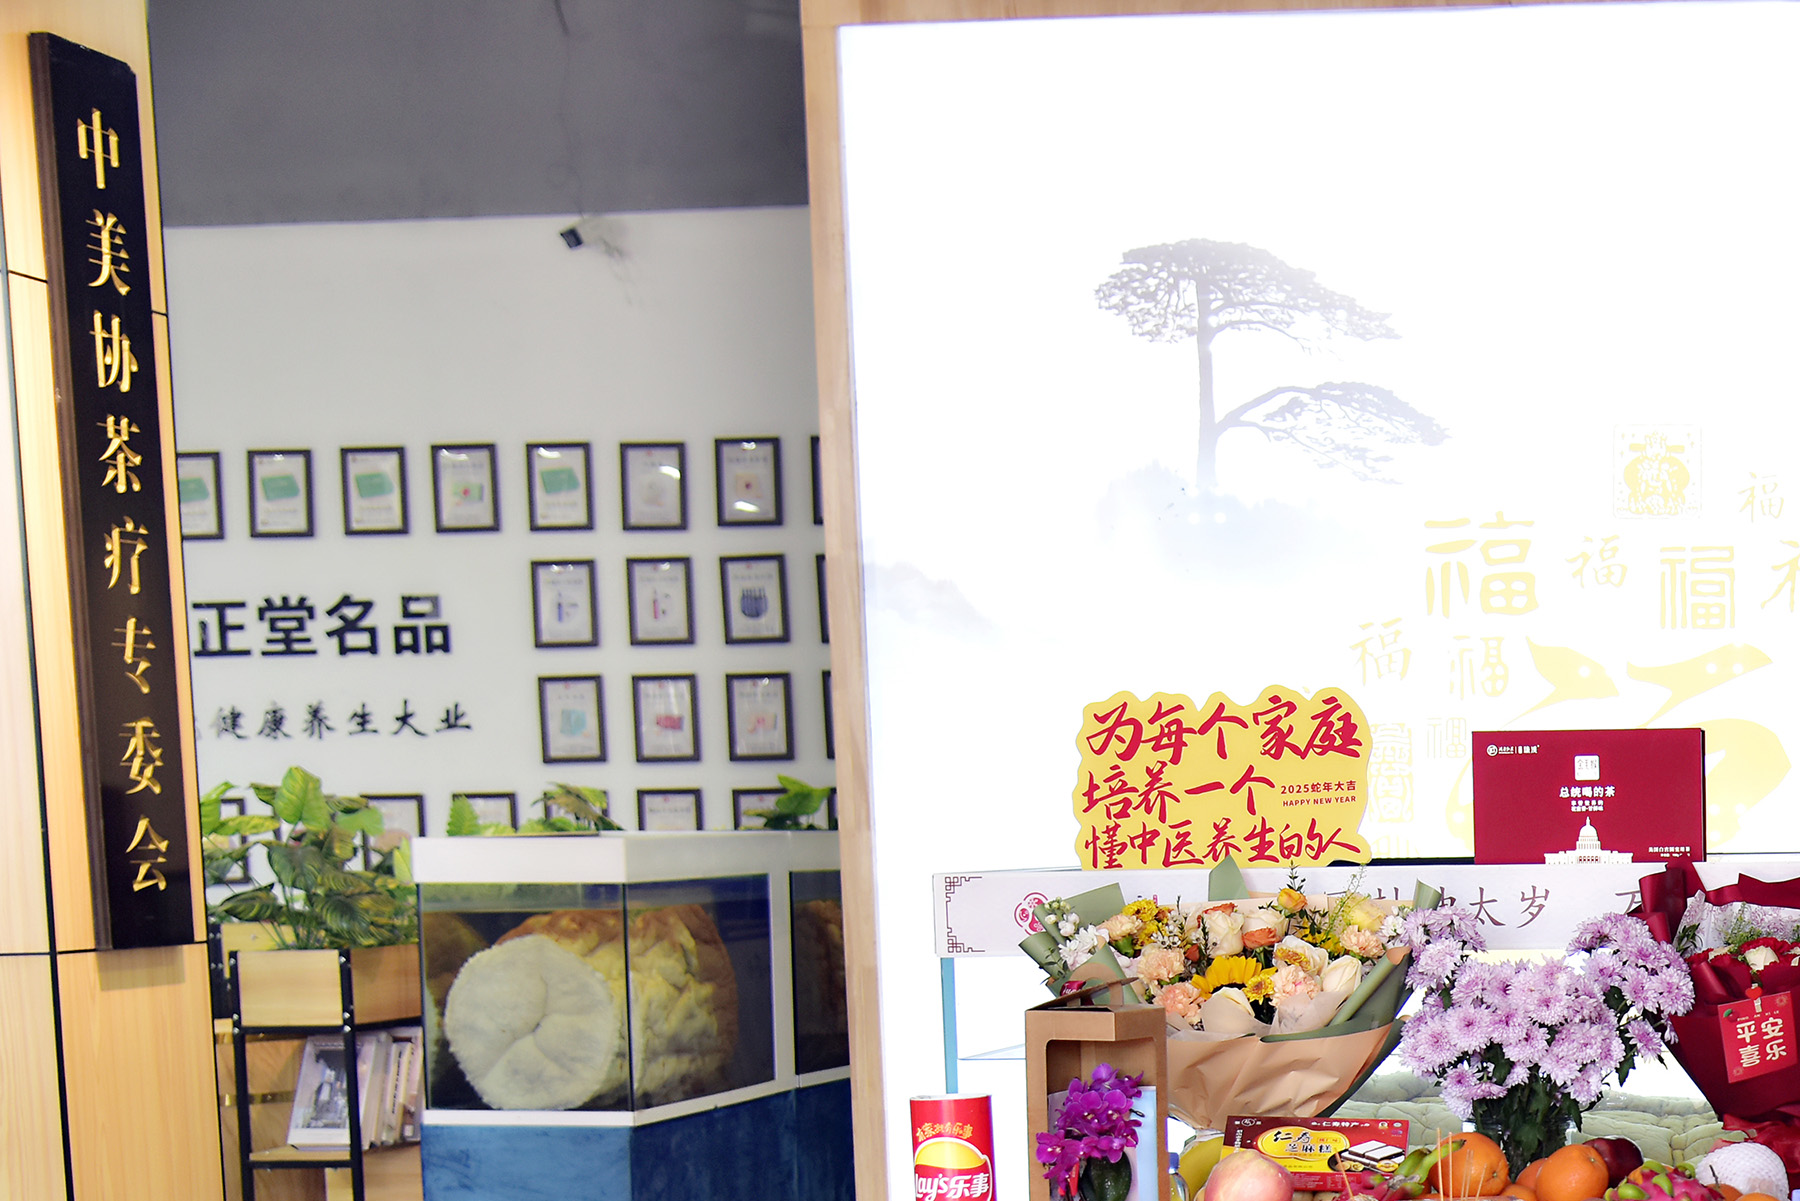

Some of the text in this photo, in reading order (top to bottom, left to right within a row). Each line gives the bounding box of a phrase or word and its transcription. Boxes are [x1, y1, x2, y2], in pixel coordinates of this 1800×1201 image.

[77, 108, 170, 893] 中美协茶疗专委会
[1425, 511, 1539, 618] 福
[192, 594, 453, 657] 正堂名品
[214, 699, 474, 741] 健康养生大业
[1085, 694, 1363, 765] 为每个家庭
[1081, 761, 1276, 824] 培养一个
[1280, 780, 1357, 795] 2025蛇年大吉
[1282, 795, 1357, 807] HAPPY NEW YEAR
[1559, 786, 1616, 798] 总统喝的茶
[1084, 816, 1361, 869] 懂中医养生的人
[1736, 1016, 1785, 1043] 平安
[1738, 1038, 1788, 1068] 喜乐
